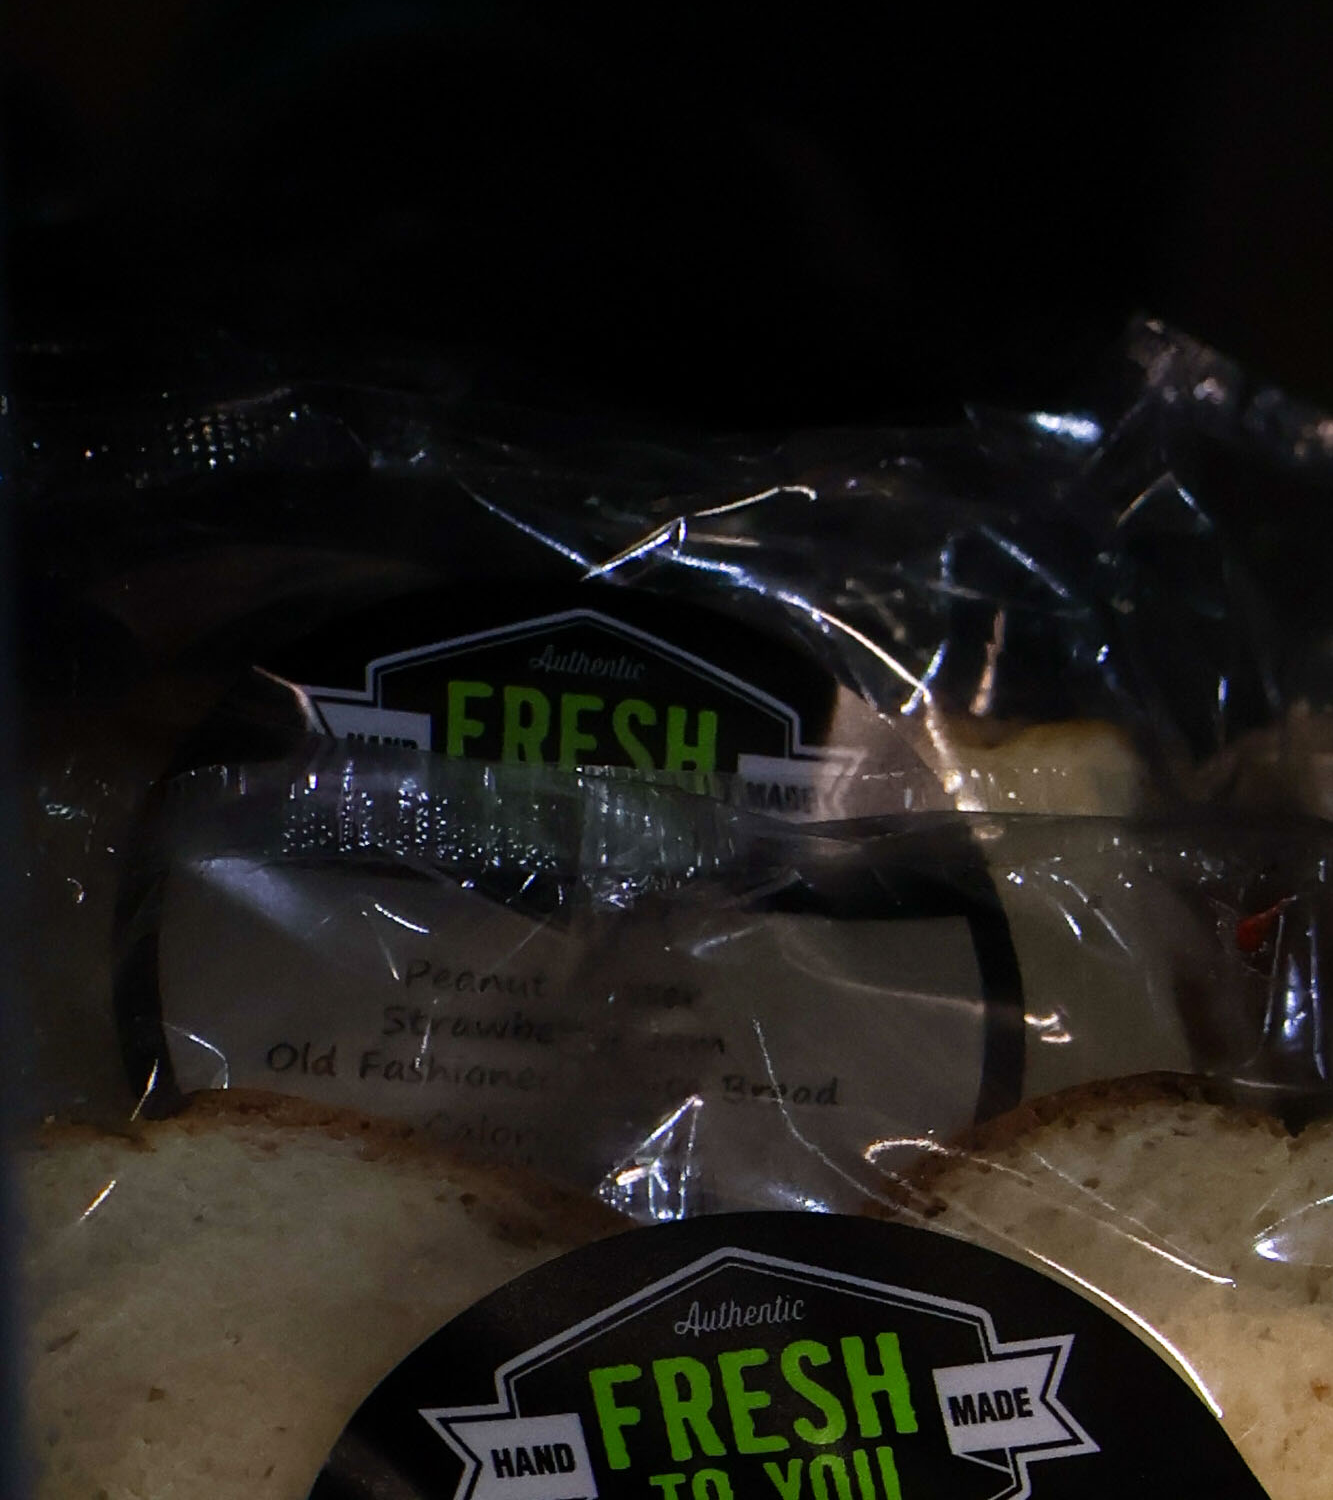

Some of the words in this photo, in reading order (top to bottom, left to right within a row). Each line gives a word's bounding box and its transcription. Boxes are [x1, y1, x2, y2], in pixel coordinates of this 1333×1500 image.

[528, 644, 648, 682] Authentic
[446, 678, 718, 795] FRESH
[404, 959, 549, 998] Peanut
[266, 1042, 337, 1079] Old
[358, 1050, 552, 1093] Fashione
[674, 1294, 806, 1337] Authentic
[588, 1331, 919, 1471] FRESH
[947, 1386, 1034, 1427] MADE
[491, 1442, 576, 1479] HAND
